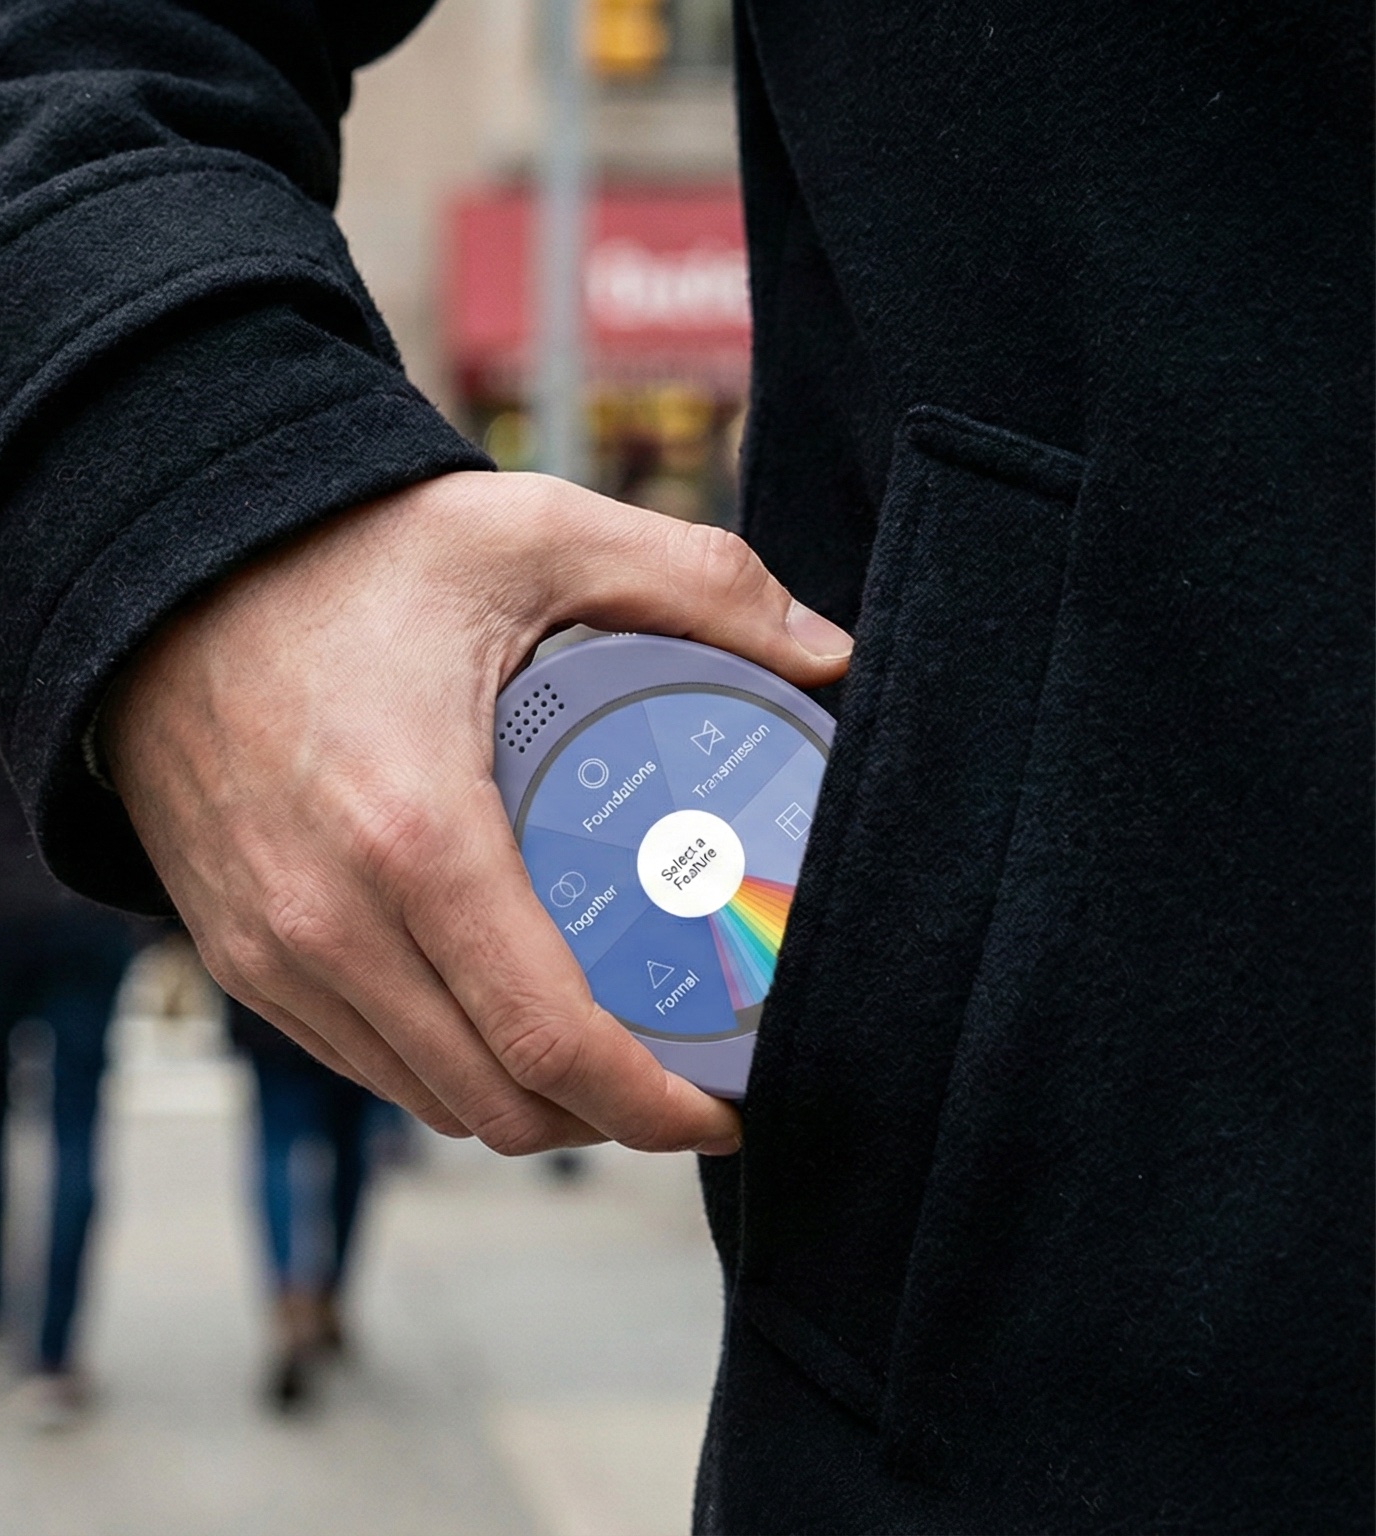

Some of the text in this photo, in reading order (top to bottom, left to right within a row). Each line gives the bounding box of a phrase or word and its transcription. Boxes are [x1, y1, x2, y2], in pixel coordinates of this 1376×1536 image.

[691, 723, 771, 799] Transmission
[582, 760, 657, 833] Foundations
[695, 837, 707, 849] a
[564, 884, 618, 936] Together
